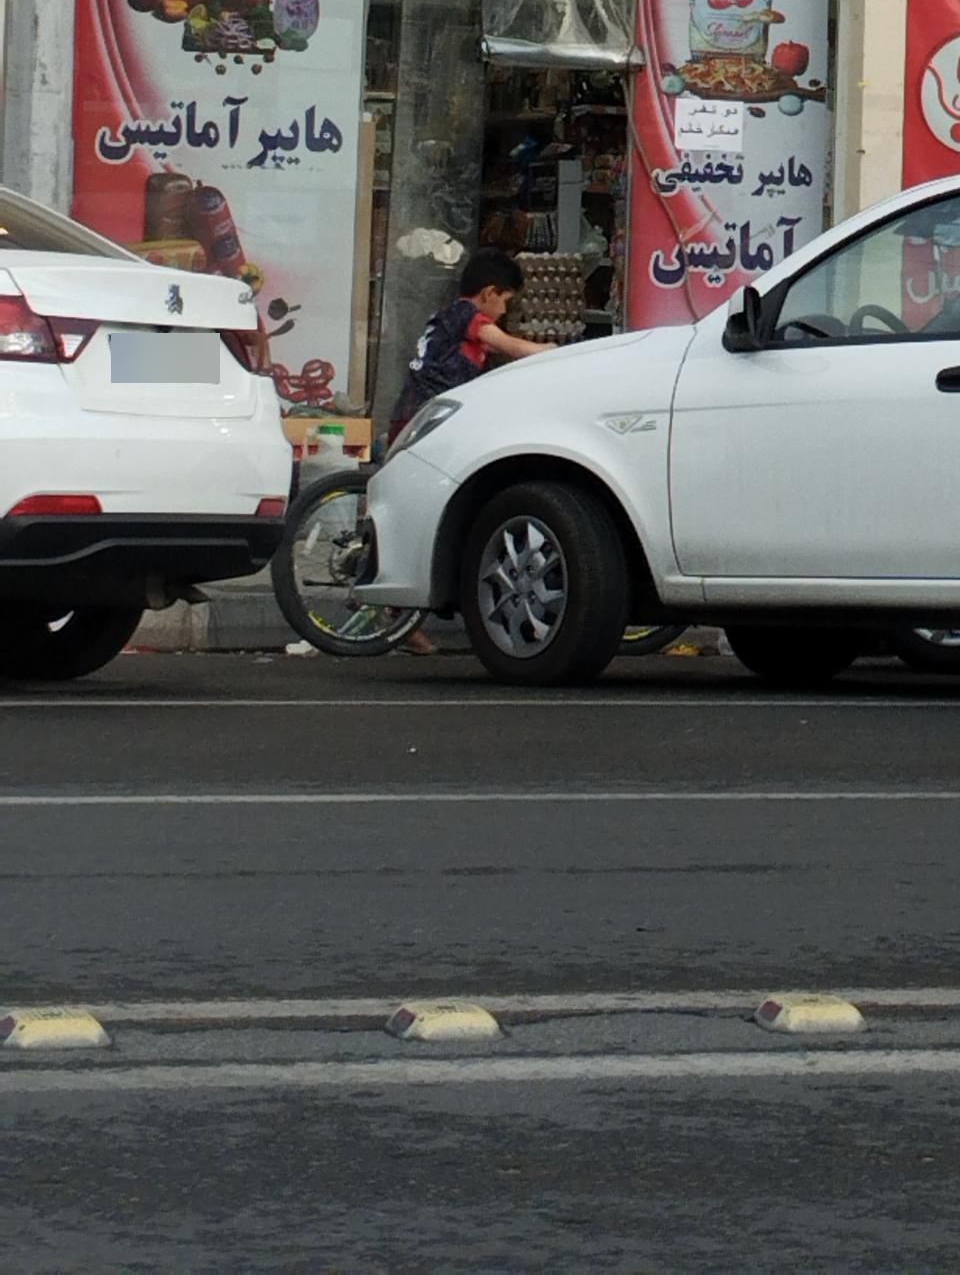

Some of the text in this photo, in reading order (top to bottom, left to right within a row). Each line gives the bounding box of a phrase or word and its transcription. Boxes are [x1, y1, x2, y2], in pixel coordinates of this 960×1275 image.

[98, 96, 343, 167] هایپر آماتیس
[654, 152, 813, 198] هایپر تخفیفی
[652, 215, 803, 284] آماتیس
